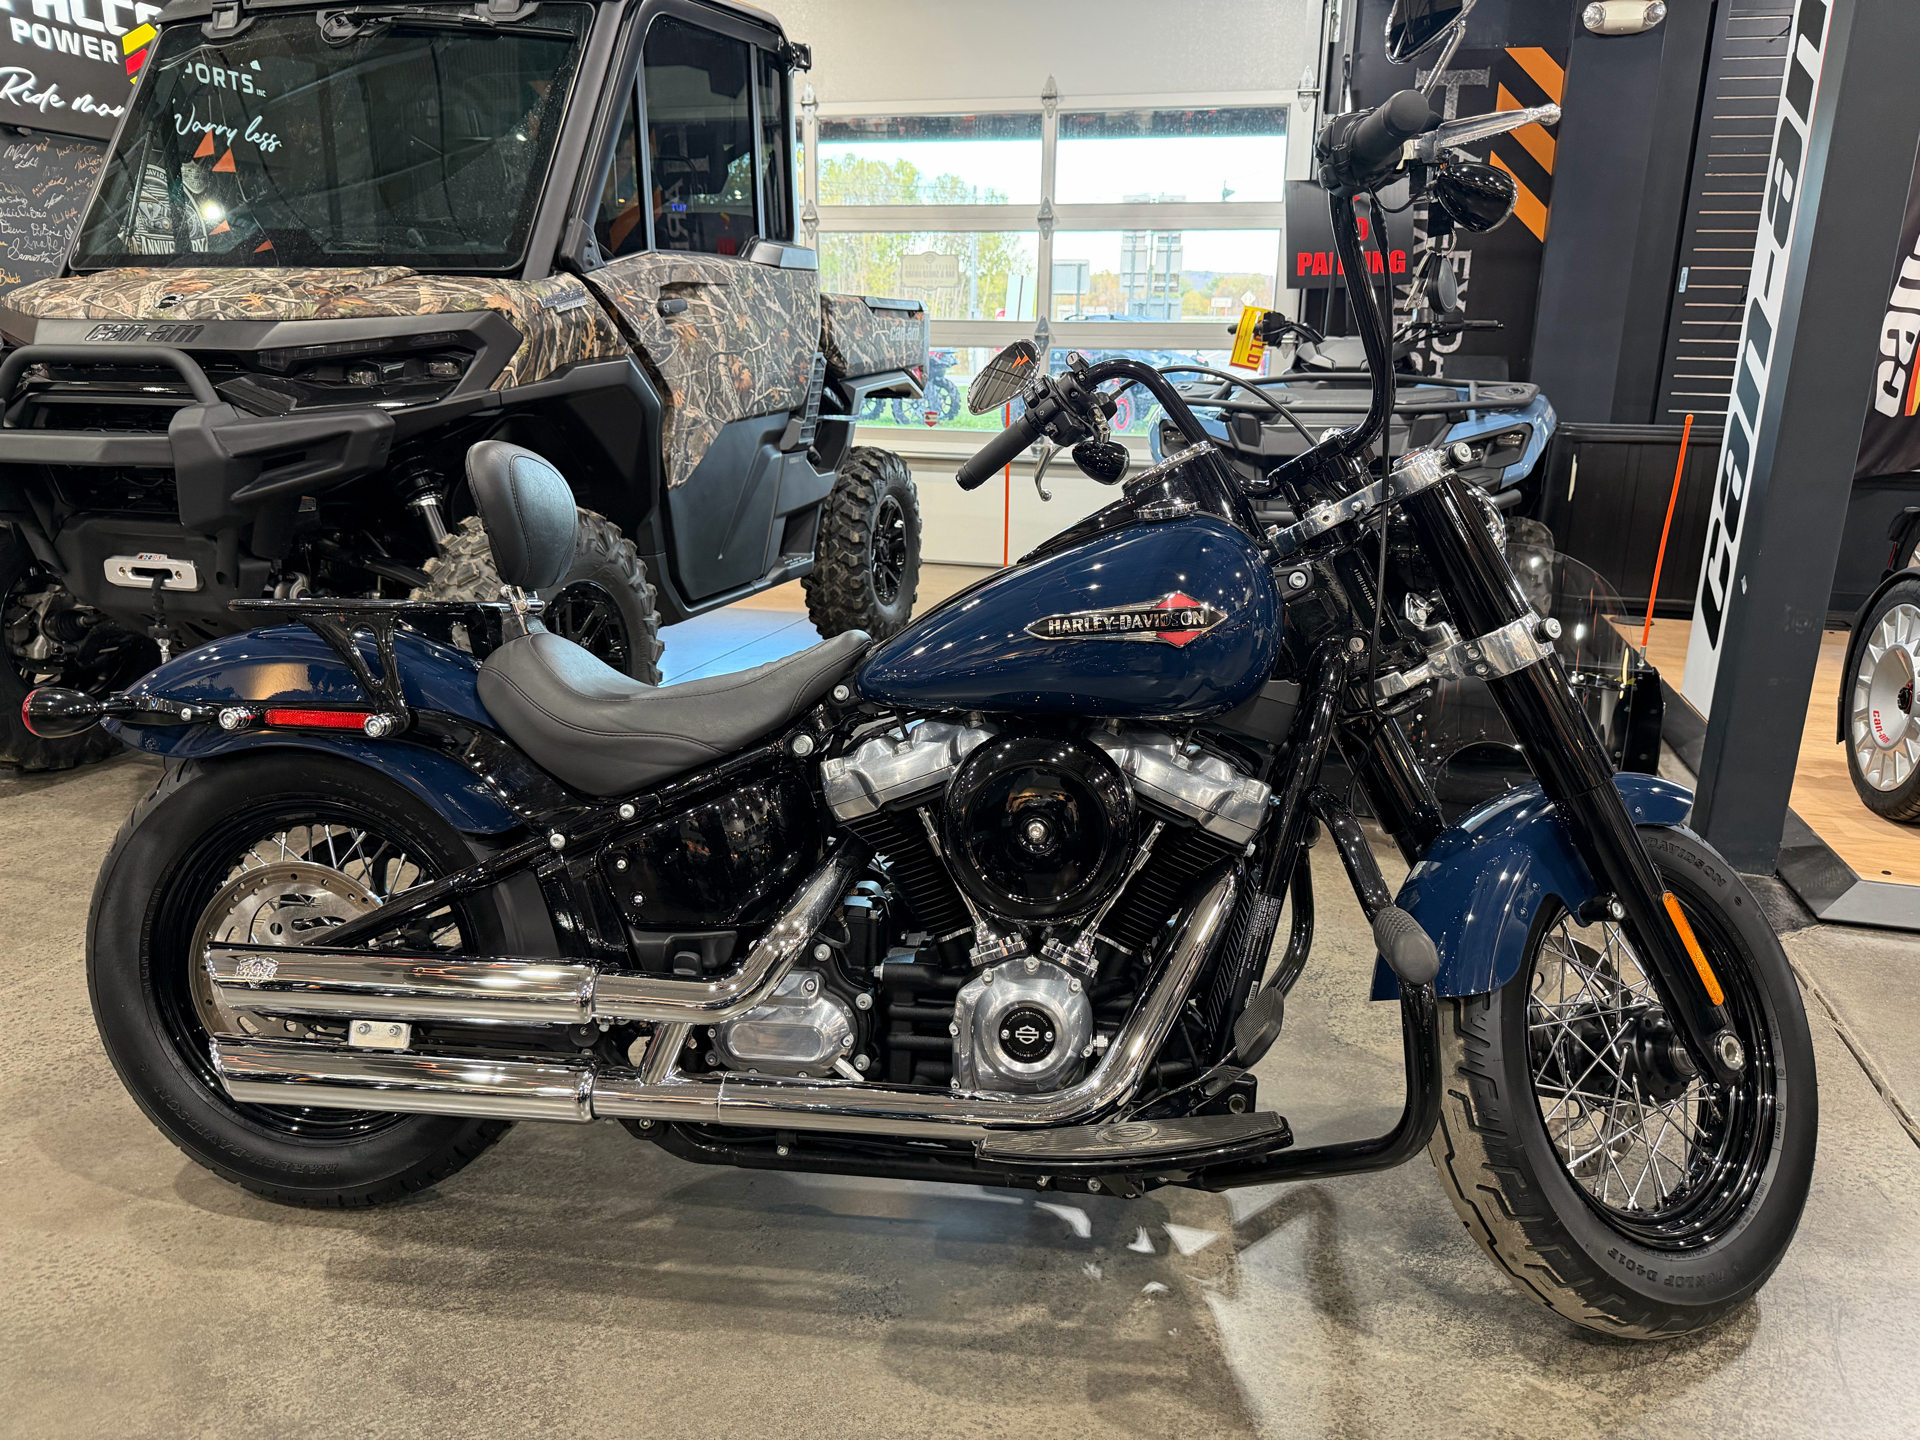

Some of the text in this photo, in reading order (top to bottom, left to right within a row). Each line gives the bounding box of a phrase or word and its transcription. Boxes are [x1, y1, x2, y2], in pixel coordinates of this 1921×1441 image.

[10, 17, 119, 65] POWER
[0, 66, 66, 114] Ride
[256, 88, 267, 98] INC
[85, 324, 205, 343] can-am
[889, 326, 920, 341] can-am
[1048, 610, 1206, 636] HARLEY-DAVIDSON
[1873, 710, 1891, 744] can-am
[153, 1085, 339, 1175] HARLEY-DAVIDSON
[1664, 1269, 1726, 1289] DUNLOP
